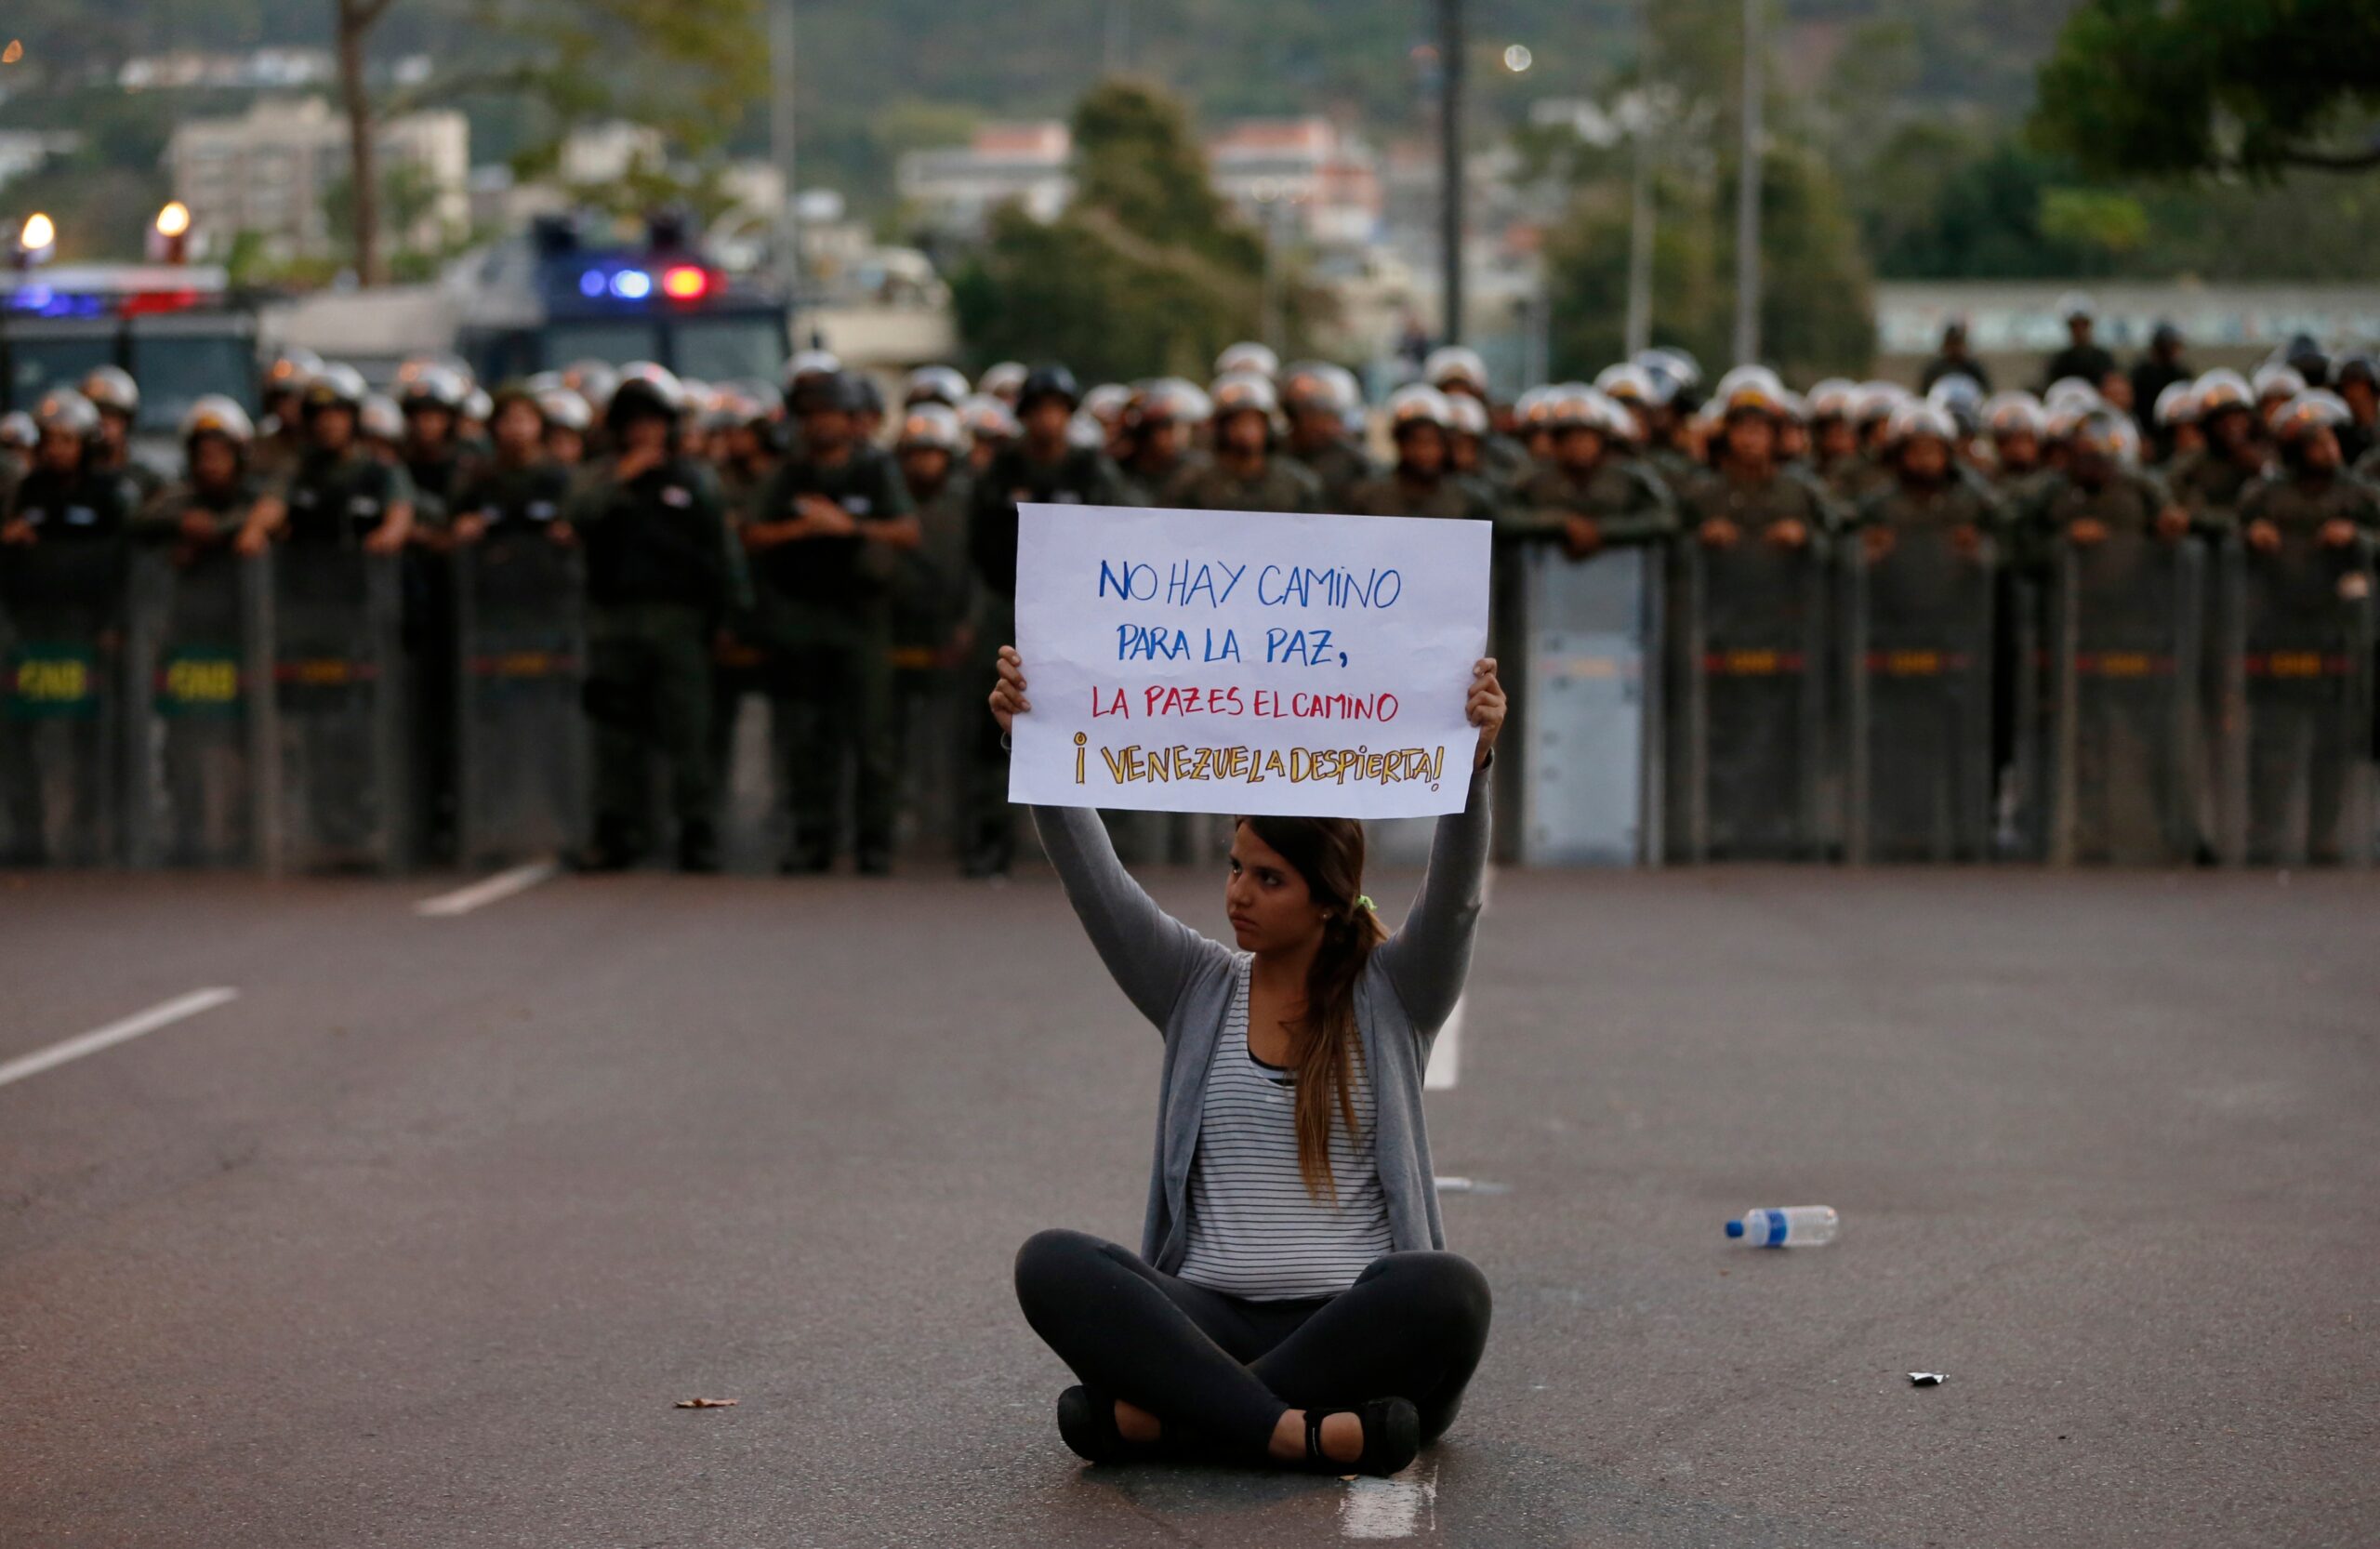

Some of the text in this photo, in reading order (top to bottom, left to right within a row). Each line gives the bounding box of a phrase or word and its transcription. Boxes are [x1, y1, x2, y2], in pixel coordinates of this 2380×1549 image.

[1099, 560, 1158, 602] NO
[1167, 559, 1247, 608] HAY
[1117, 623, 1348, 669] PARA LA PAZ,
[1092, 685, 1130, 720] LA
[1144, 685, 1204, 718] PAZ
[1207, 685, 1244, 716] ES
[1253, 690, 1289, 719] EL
[1101, 744, 1286, 785] VENEZUELA
